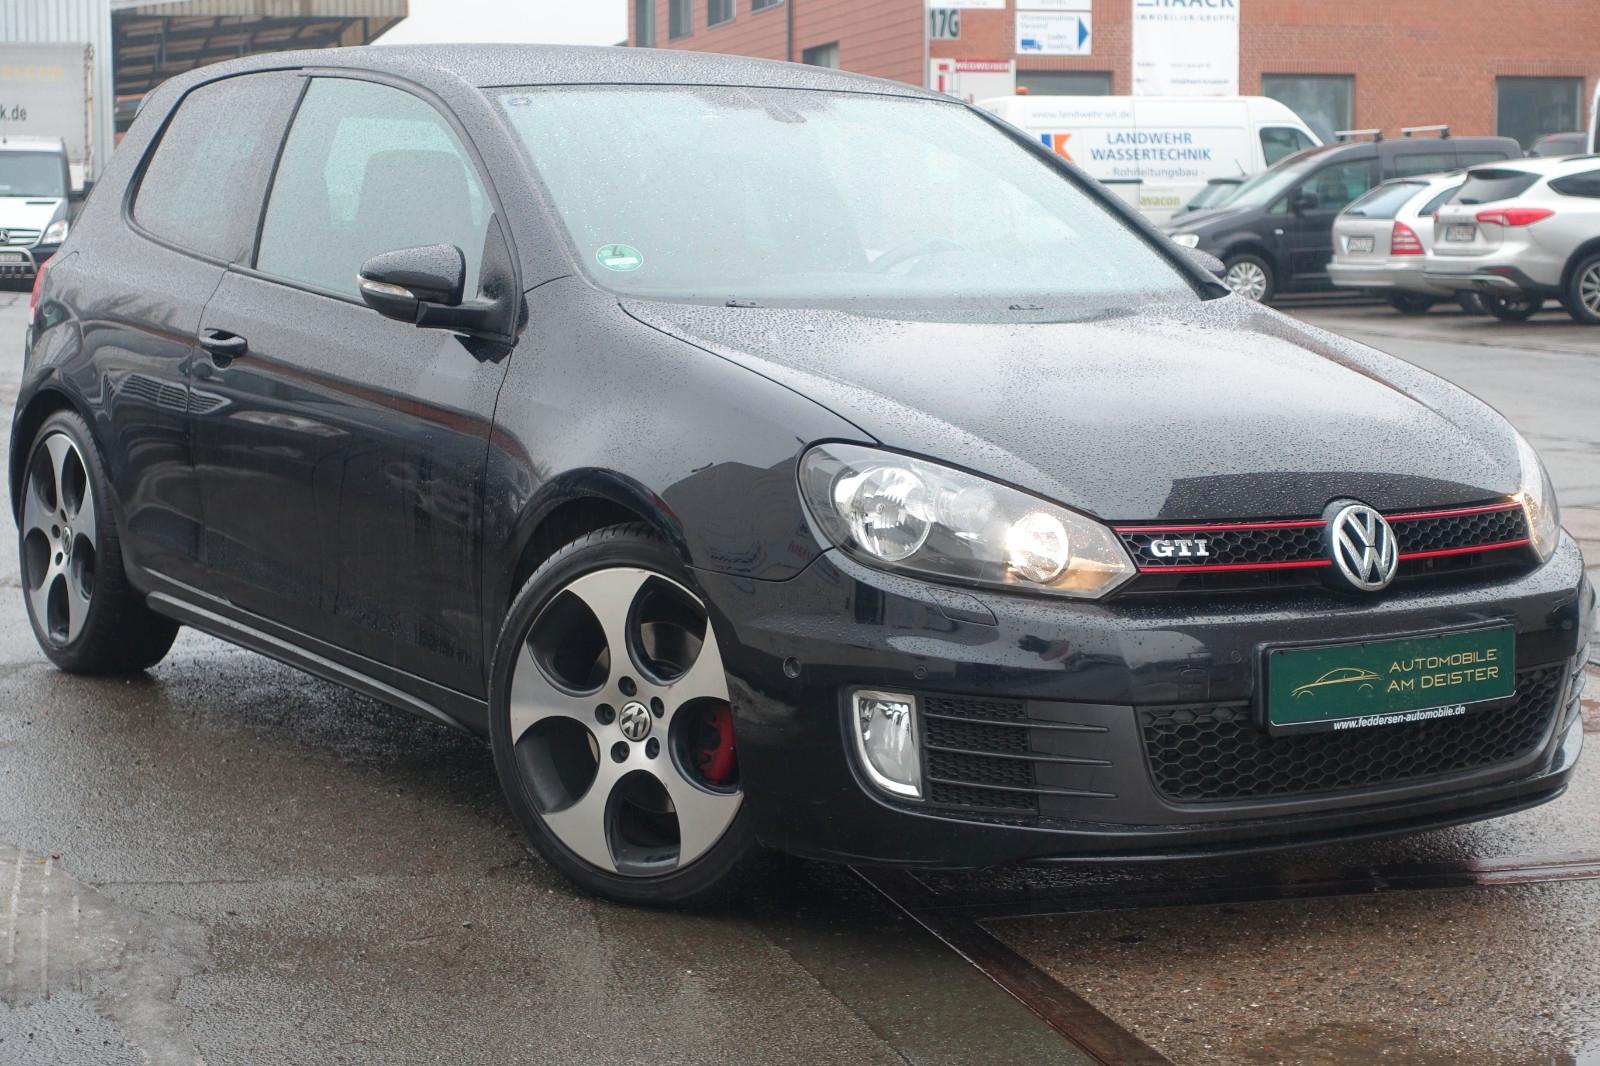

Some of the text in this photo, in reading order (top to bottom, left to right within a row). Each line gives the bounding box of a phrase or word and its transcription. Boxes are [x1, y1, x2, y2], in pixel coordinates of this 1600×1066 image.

[931, 8, 959, 38] 17G
[1107, 132, 1193, 145] LANDWEHR
[1091, 148, 1212, 161] WASSERTECHNIK
[1150, 539, 1210, 557] GTI
[1388, 648, 1498, 674] AUTOMOBILE
[1387, 666, 1500, 693] AM DEISTER
[1333, 704, 1467, 730] www.feddersen-automobile.de
